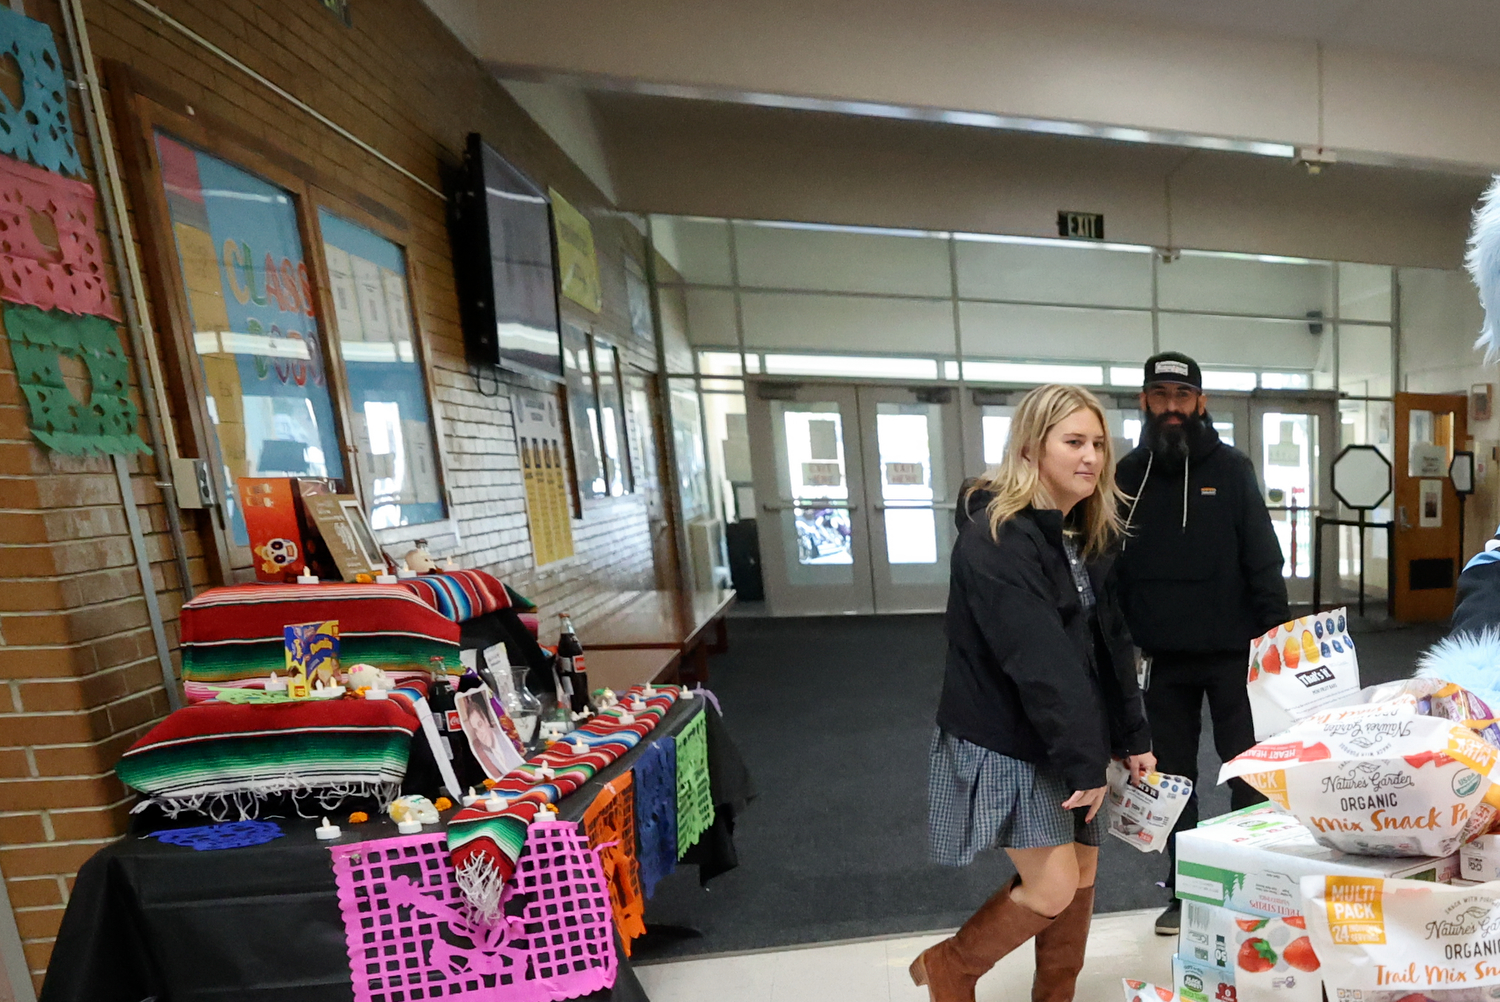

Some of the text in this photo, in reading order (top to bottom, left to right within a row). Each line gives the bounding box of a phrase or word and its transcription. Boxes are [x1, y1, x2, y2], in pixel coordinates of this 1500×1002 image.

[1067, 212, 1097, 239] EXIT
[223, 239, 316, 318] CLASS
[1298, 669, 1325, 686] That's
[1323, 720, 1362, 738] Garden
[1269, 748, 1296, 759] HEART
[1322, 770, 1415, 794] Nature's Garden
[1340, 792, 1398, 812] ORGANIC
[1310, 805, 1442, 833] Mix Snack
[1331, 884, 1376, 902] MULTI
[1250, 899, 1278, 914] STRIPS
[1334, 902, 1375, 920] PACK
[1444, 899, 1462, 915] SNACK
[1332, 925, 1350, 943] 24
[1425, 920, 1478, 941] Nature's
[1374, 962, 1420, 986] Trail
[1423, 963, 1467, 986] Mix
